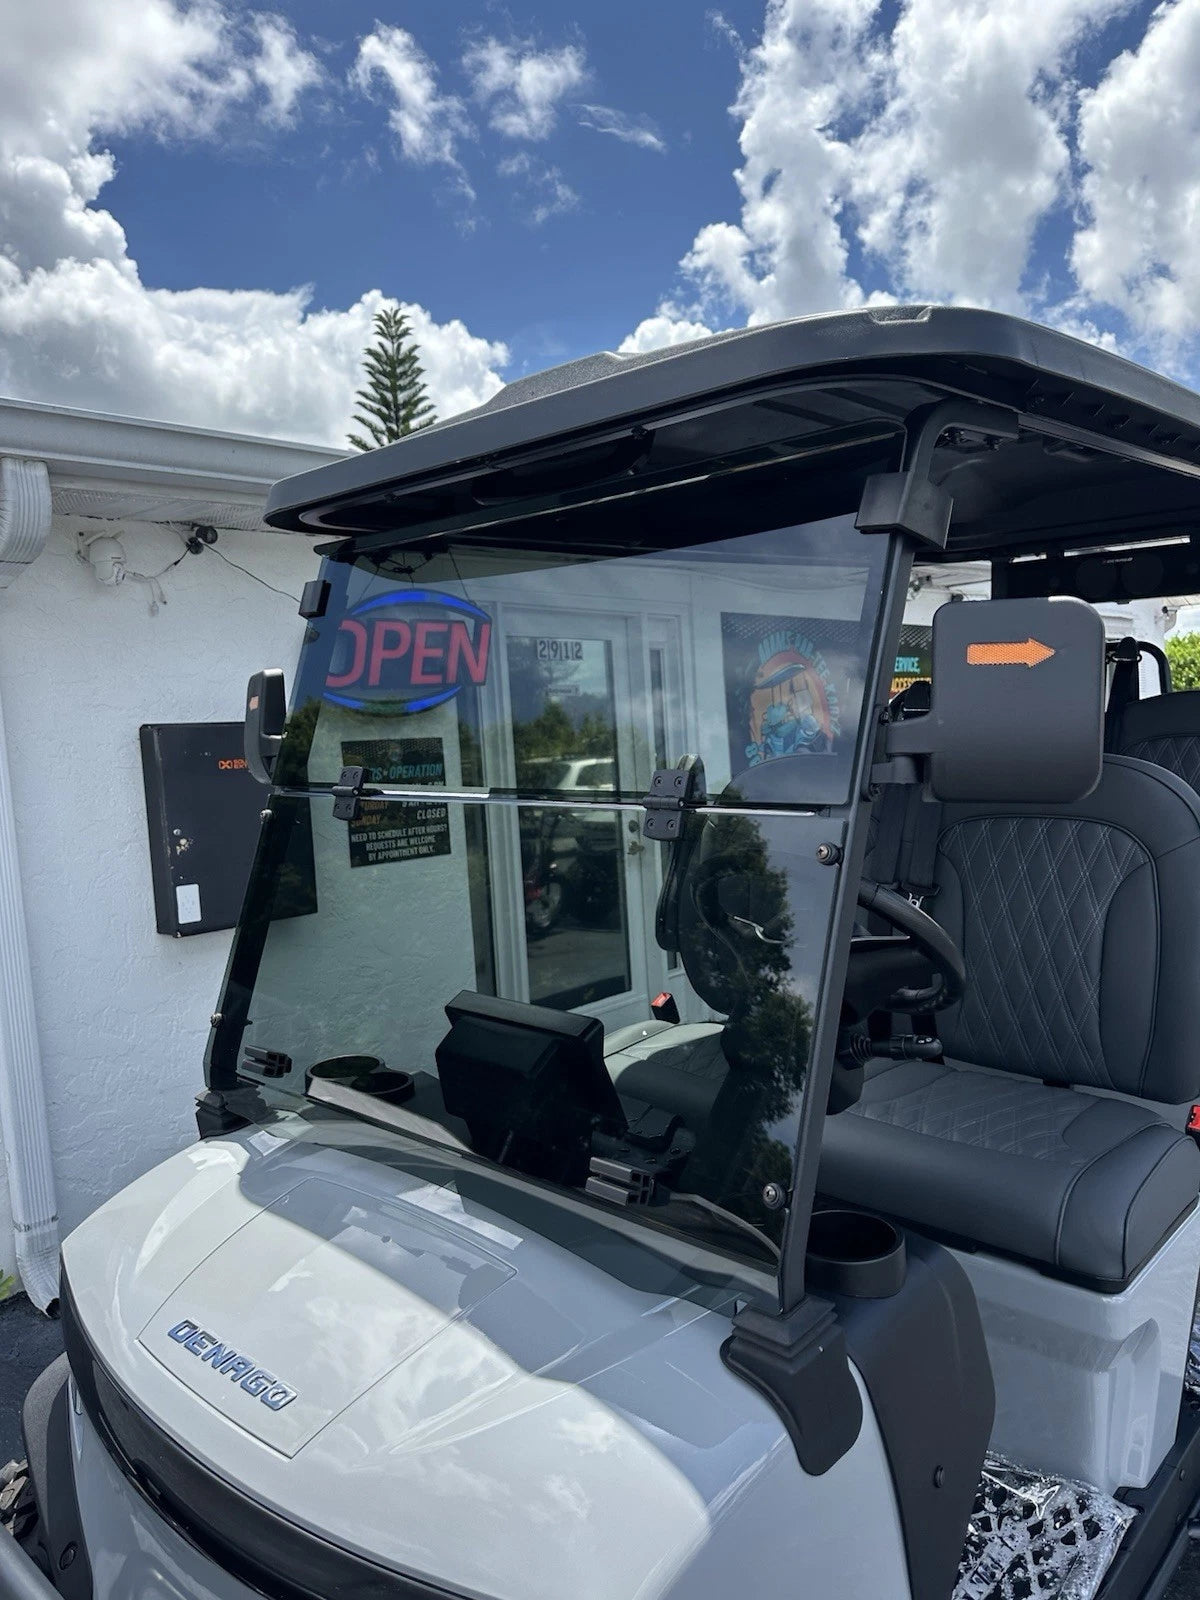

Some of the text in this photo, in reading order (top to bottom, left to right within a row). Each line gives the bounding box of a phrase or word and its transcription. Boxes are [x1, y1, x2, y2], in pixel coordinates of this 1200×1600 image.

[325, 619, 492, 688] OPEN
[539, 640, 582, 659] 2912
[389, 763, 443, 779] OPERATION
[417, 808, 446, 820] CLOSED
[351, 832, 367, 843] NEED
[369, 831, 376, 841] TO
[377, 828, 407, 840] SCHEDULE
[408, 825, 425, 837] AFTER
[366, 835, 436, 851] REQUESTS ARE WELCOME
[368, 852, 377, 862] BY
[378, 847, 418, 860] APPOINTMENT
[168, 1319, 297, 1411] DENAGO
